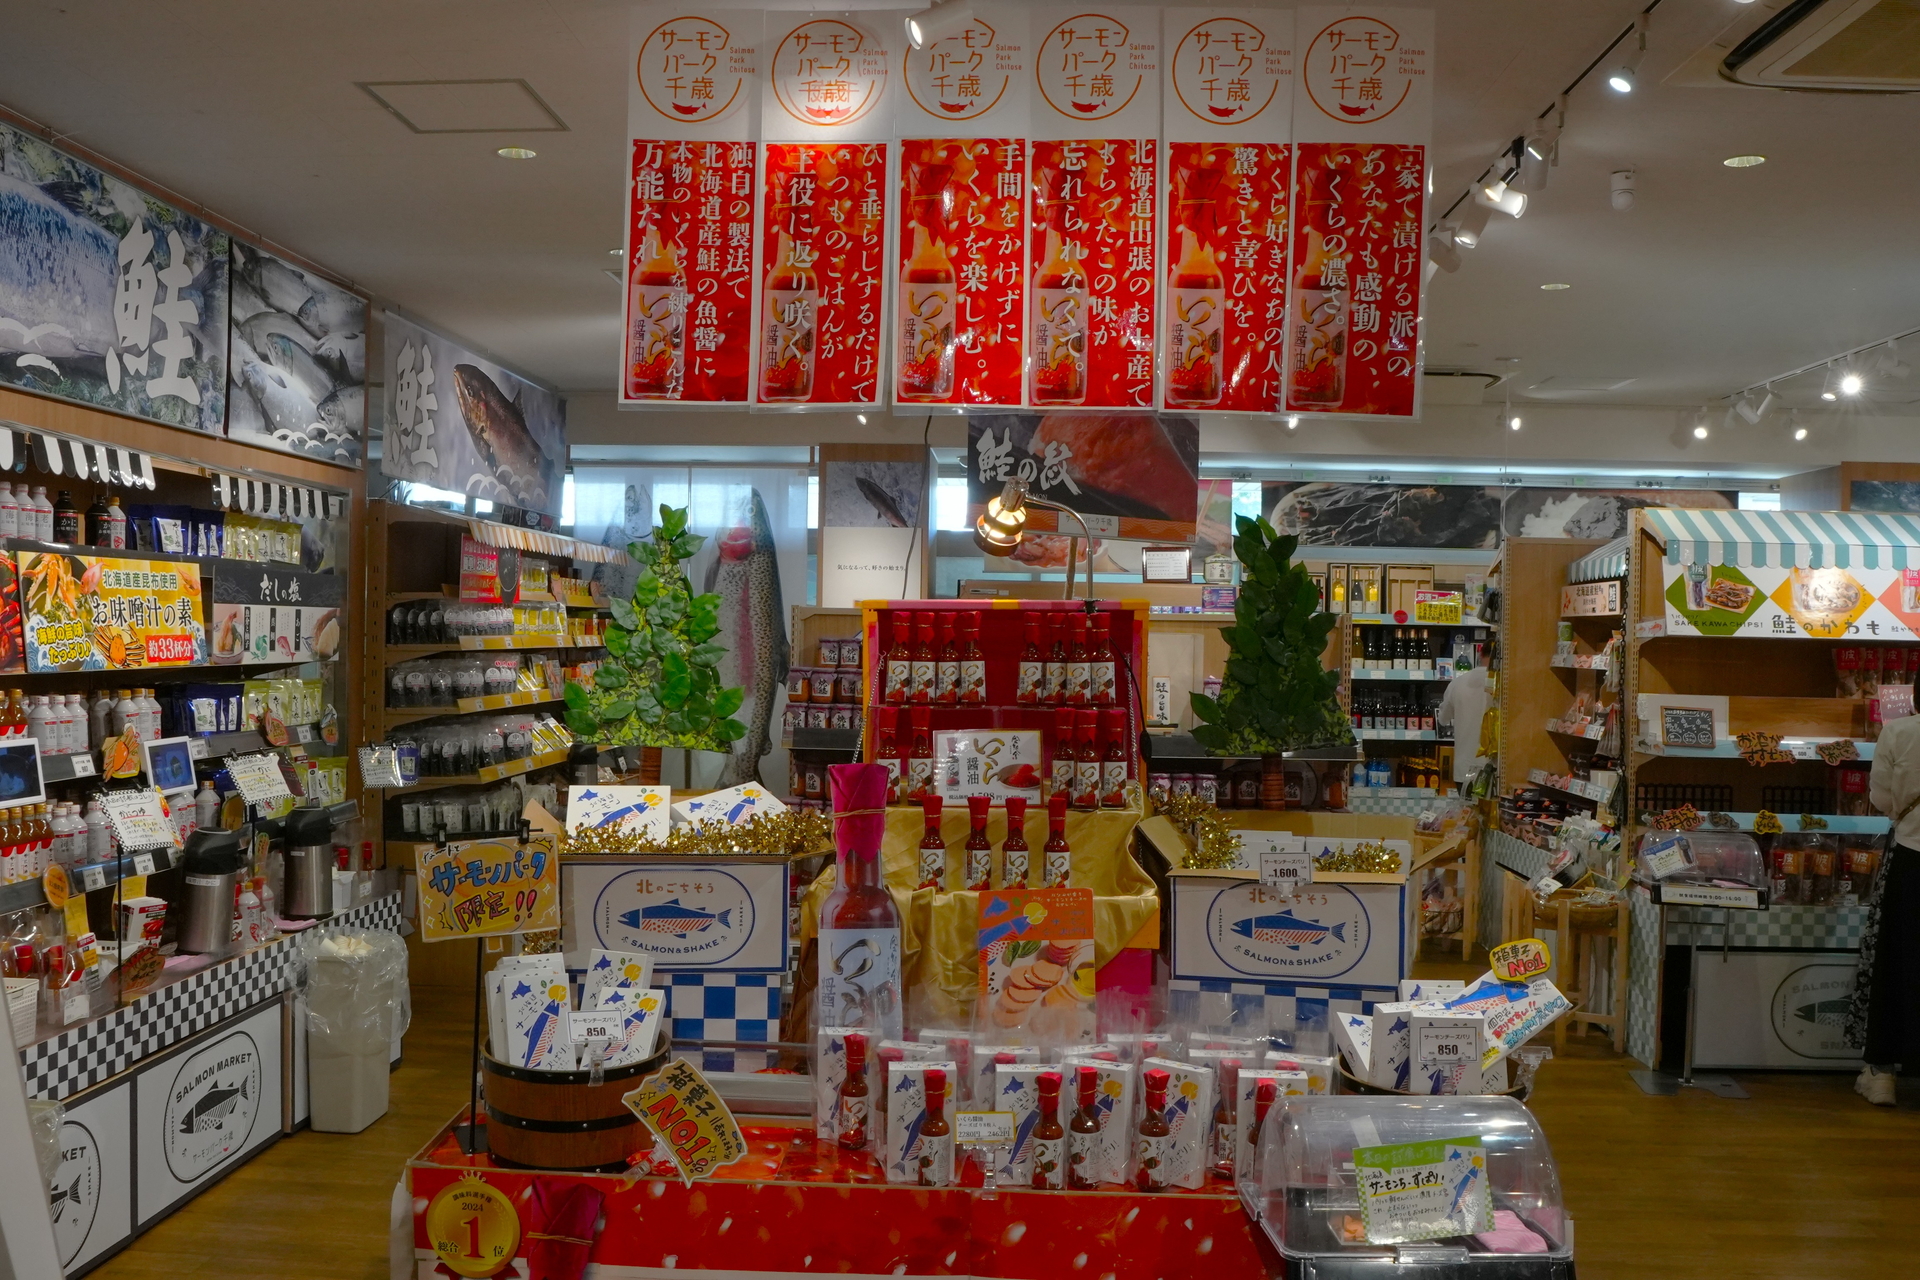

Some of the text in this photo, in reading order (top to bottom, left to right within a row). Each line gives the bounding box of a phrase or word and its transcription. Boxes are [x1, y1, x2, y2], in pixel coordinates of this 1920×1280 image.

[659, 30, 730, 52] サーモン
[794, 33, 863, 54] サーモン
[996, 44, 1020, 52] Salmon
[1058, 29, 1130, 48] サーモン
[1129, 43, 1155, 51] Salmon
[1194, 31, 1266, 52] サーモン
[1327, 30, 1400, 51] サーモン
[663, 52, 717, 74] パーク
[730, 56, 745, 64] Park
[863, 58, 878, 66] Park
[929, 52, 983, 73] パーク
[1061, 51, 1117, 74] パーク
[1266, 48, 1291, 56] Salmon
[1399, 48, 1425, 56] Salmon
[798, 56, 850, 76] パーク
[863, 68, 888, 76] Chitose
[996, 63, 1021, 71] Chitose
[1199, 54, 1253, 75] パーク
[1330, 54, 1386, 75] パーク
[665, 77, 714, 100] 千歳
[799, 80, 848, 102] 千歳
[931, 75, 981, 97] 千歳
[1064, 76, 1114, 98] 千歳
[1200, 79, 1251, 101] 千歳
[1331, 77, 1383, 101] 千歳
[636, 141, 665, 261] 万能たれ
[727, 144, 752, 299] 独自の製法で
[996, 144, 1024, 344] 手間をかけずに
[1092, 143, 1118, 346] もらったこの味が
[1231, 146, 1259, 343] 驚きと喜びを。
[1319, 153, 1349, 325] いくらの濃さ。
[694, 144, 723, 376] 北海道産鮭の魚醤に
[783, 148, 817, 372] 主役に返り咲く。
[822, 148, 850, 360] いつものごはんが
[959, 144, 990, 371] いくらを楽しむ。
[1059, 141, 1089, 373] 忘れられなくて。
[1353, 152, 1385, 377] あなたも感動の、
[1387, 148, 1422, 377] 「家で漬ける派」の
[666, 144, 694, 400] 本物のいくらを練りこんだ
[852, 145, 883, 402] ひと垂らしするだけで
[1127, 139, 1154, 407] 北海道出張のお土産で
[105, 215, 200, 405] 鮭
[392, 338, 439, 468] 鮭
[837, 564, 908, 572] 気になるって、好きの始まり。
[102, 570, 178, 590] 北海道産昆布使用
[260, 573, 302, 602] だしの塩
[92, 597, 192, 628] お味噌汁の素
[36, 621, 84, 644] 海鮮の旨味
[148, 637, 194, 660] 約33杯分
[967, 757, 979, 785] 醤油
[429, 851, 547, 897] サーモンパーク
[1273, 867, 1297, 879] 1,600
[636, 879, 715, 894] 北のごちそう
[630, 938, 720, 954] SALMON&SHAKE
[1492, 944, 1531, 963] 箱菓子
[1243, 949, 1334, 966] SALMON&SHAKE
[1508, 953, 1547, 977] No1
[586, 1027, 606, 1036] 850
[1438, 1045, 1458, 1055] 850
[176, 1053, 252, 1103] SALMON MARKET
[666, 1063, 716, 1118] 箱菓子
[462, 1202, 484, 1211] 2024
[437, 1241, 459, 1253] 総合
[463, 1216, 485, 1258] 1
[493, 1246, 504, 1257] 位
